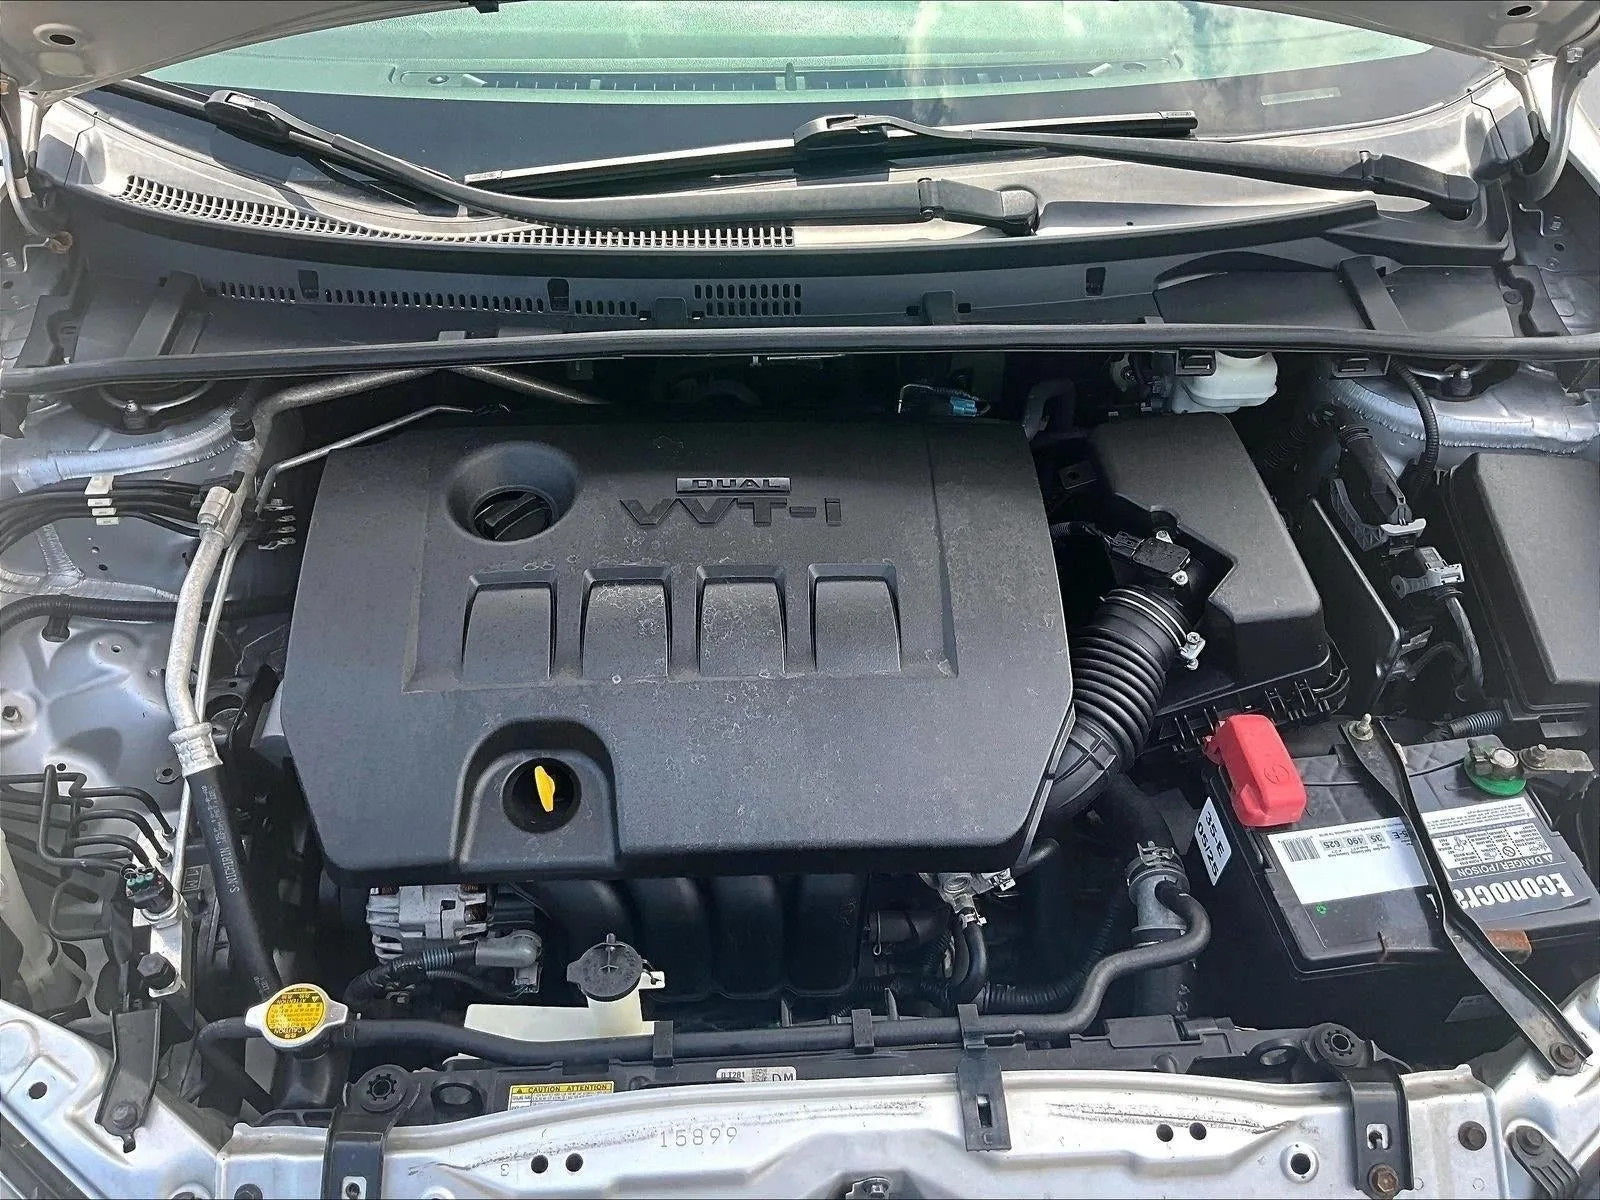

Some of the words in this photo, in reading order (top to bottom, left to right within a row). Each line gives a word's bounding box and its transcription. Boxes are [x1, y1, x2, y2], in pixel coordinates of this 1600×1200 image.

[691, 478, 781, 489] DUAL
[1206, 811, 1225, 858] 35-E
[1370, 834, 1382, 843] 35
[1501, 856, 1546, 871] DANGER
[528, 1086, 561, 1094] CAUTION
[567, 1083, 608, 1092] ATTENTION
[660, 1126, 738, 1148] 15899
